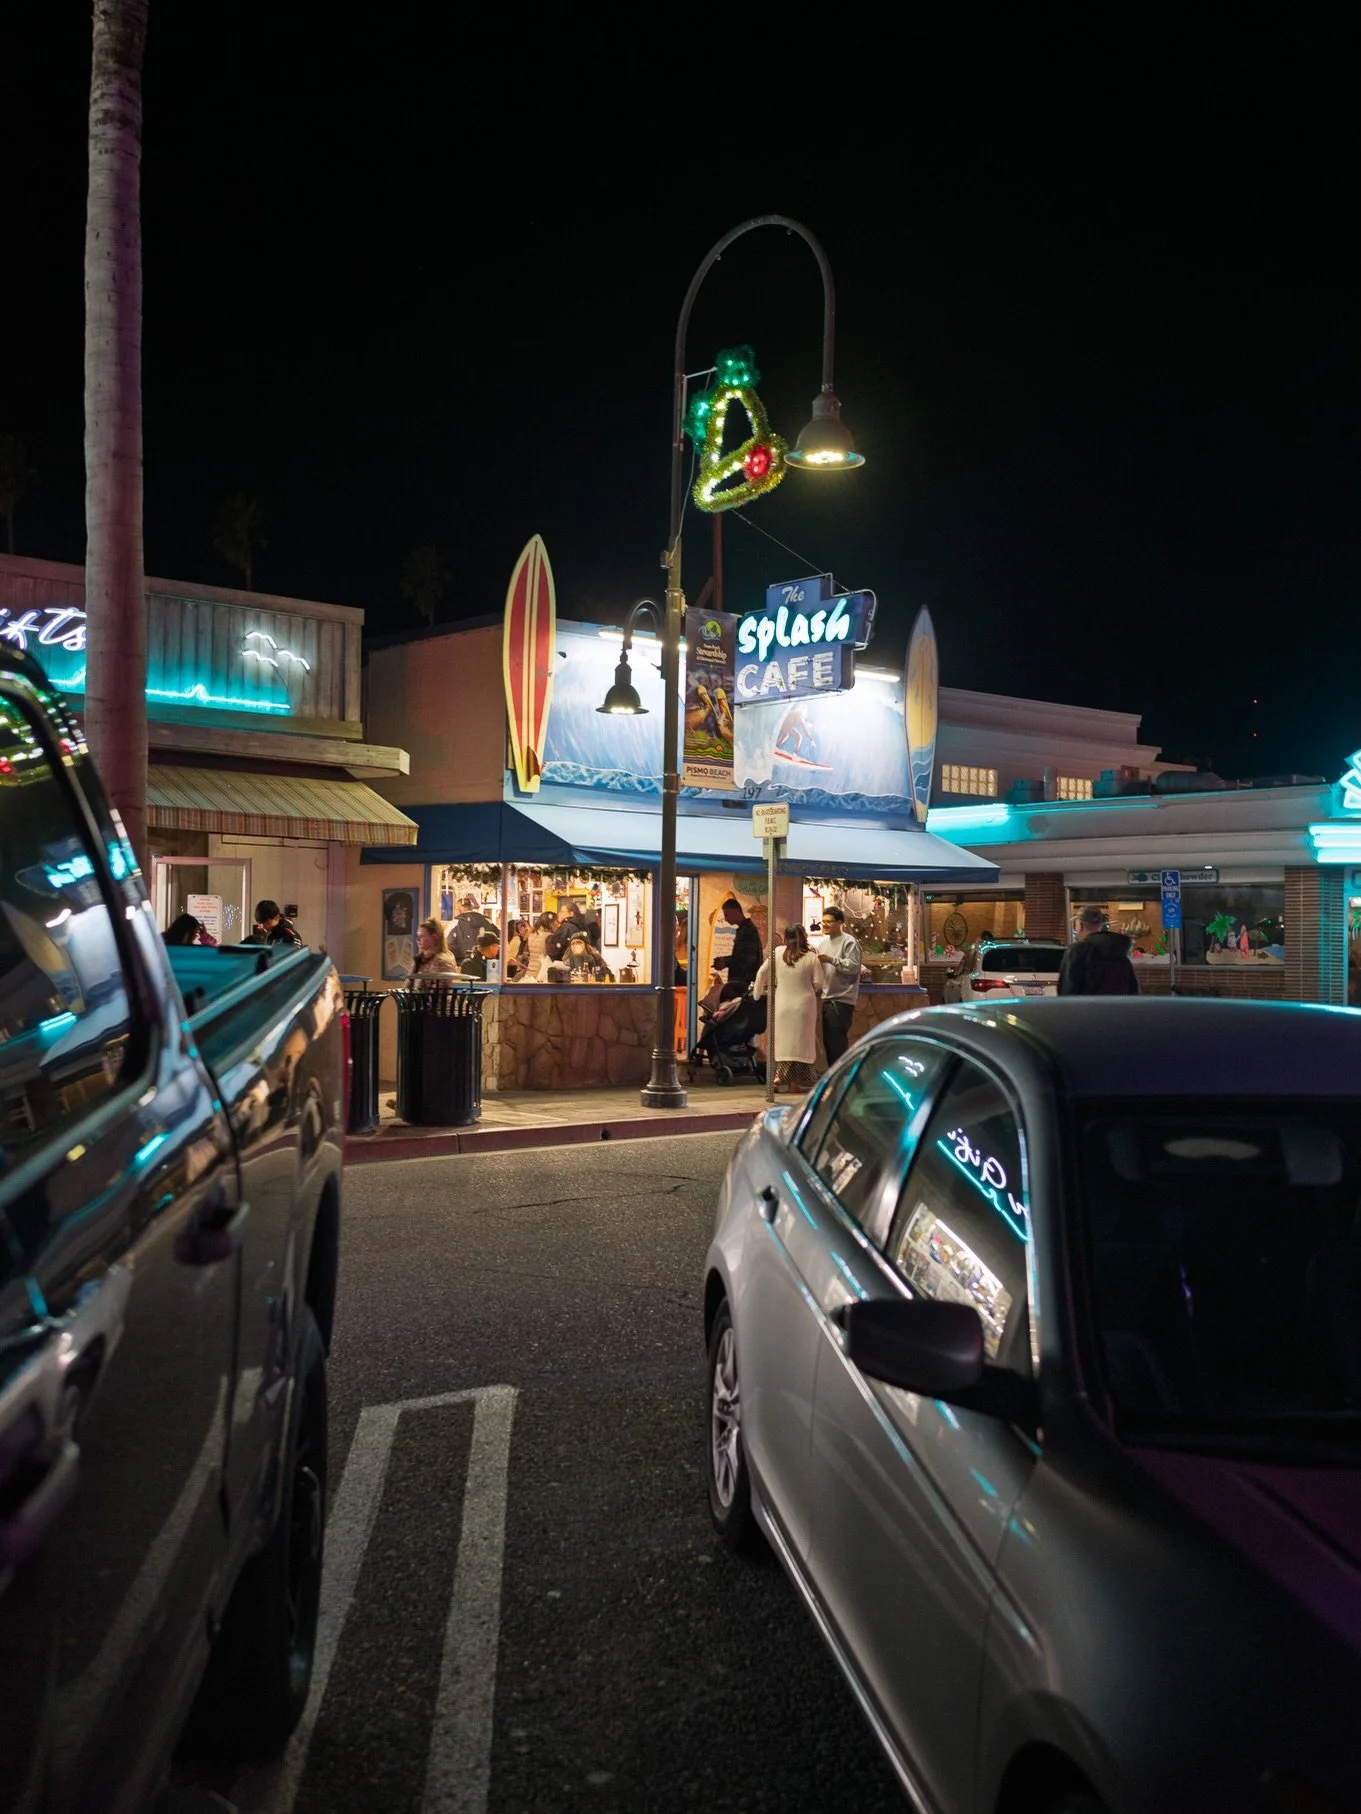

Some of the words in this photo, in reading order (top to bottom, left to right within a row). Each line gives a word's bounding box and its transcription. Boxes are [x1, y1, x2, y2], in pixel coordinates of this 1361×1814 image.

[781, 585, 805, 604] The
[736, 651, 834, 698] CAFE
[686, 766, 709, 775] PISMO
[709, 769, 731, 777] BEACH
[743, 787, 762, 799] 197
